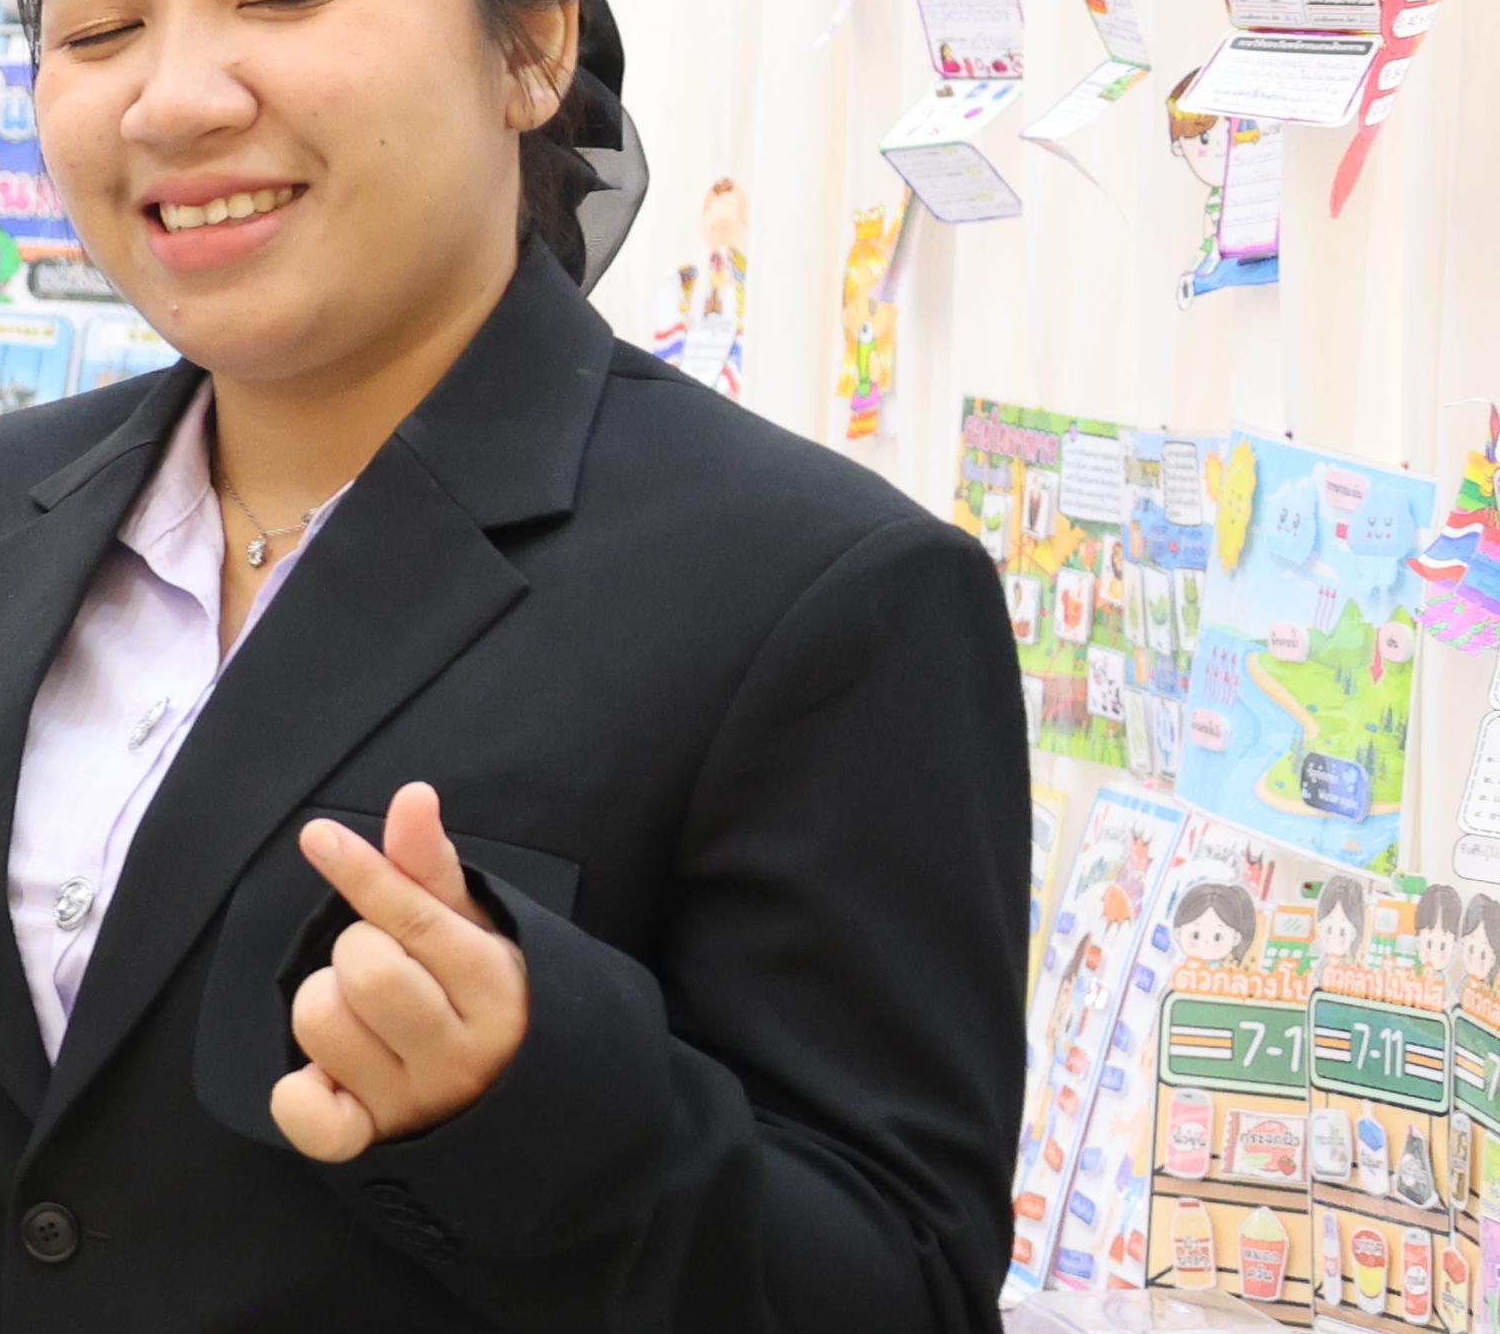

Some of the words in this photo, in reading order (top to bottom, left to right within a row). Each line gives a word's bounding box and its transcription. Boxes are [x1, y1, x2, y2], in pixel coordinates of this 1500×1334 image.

[1174, 957, 1309, 1001] ตัวกลางโป
[1238, 1020, 1306, 1074] 7-1
[1352, 1022, 1404, 1078] 7-11
